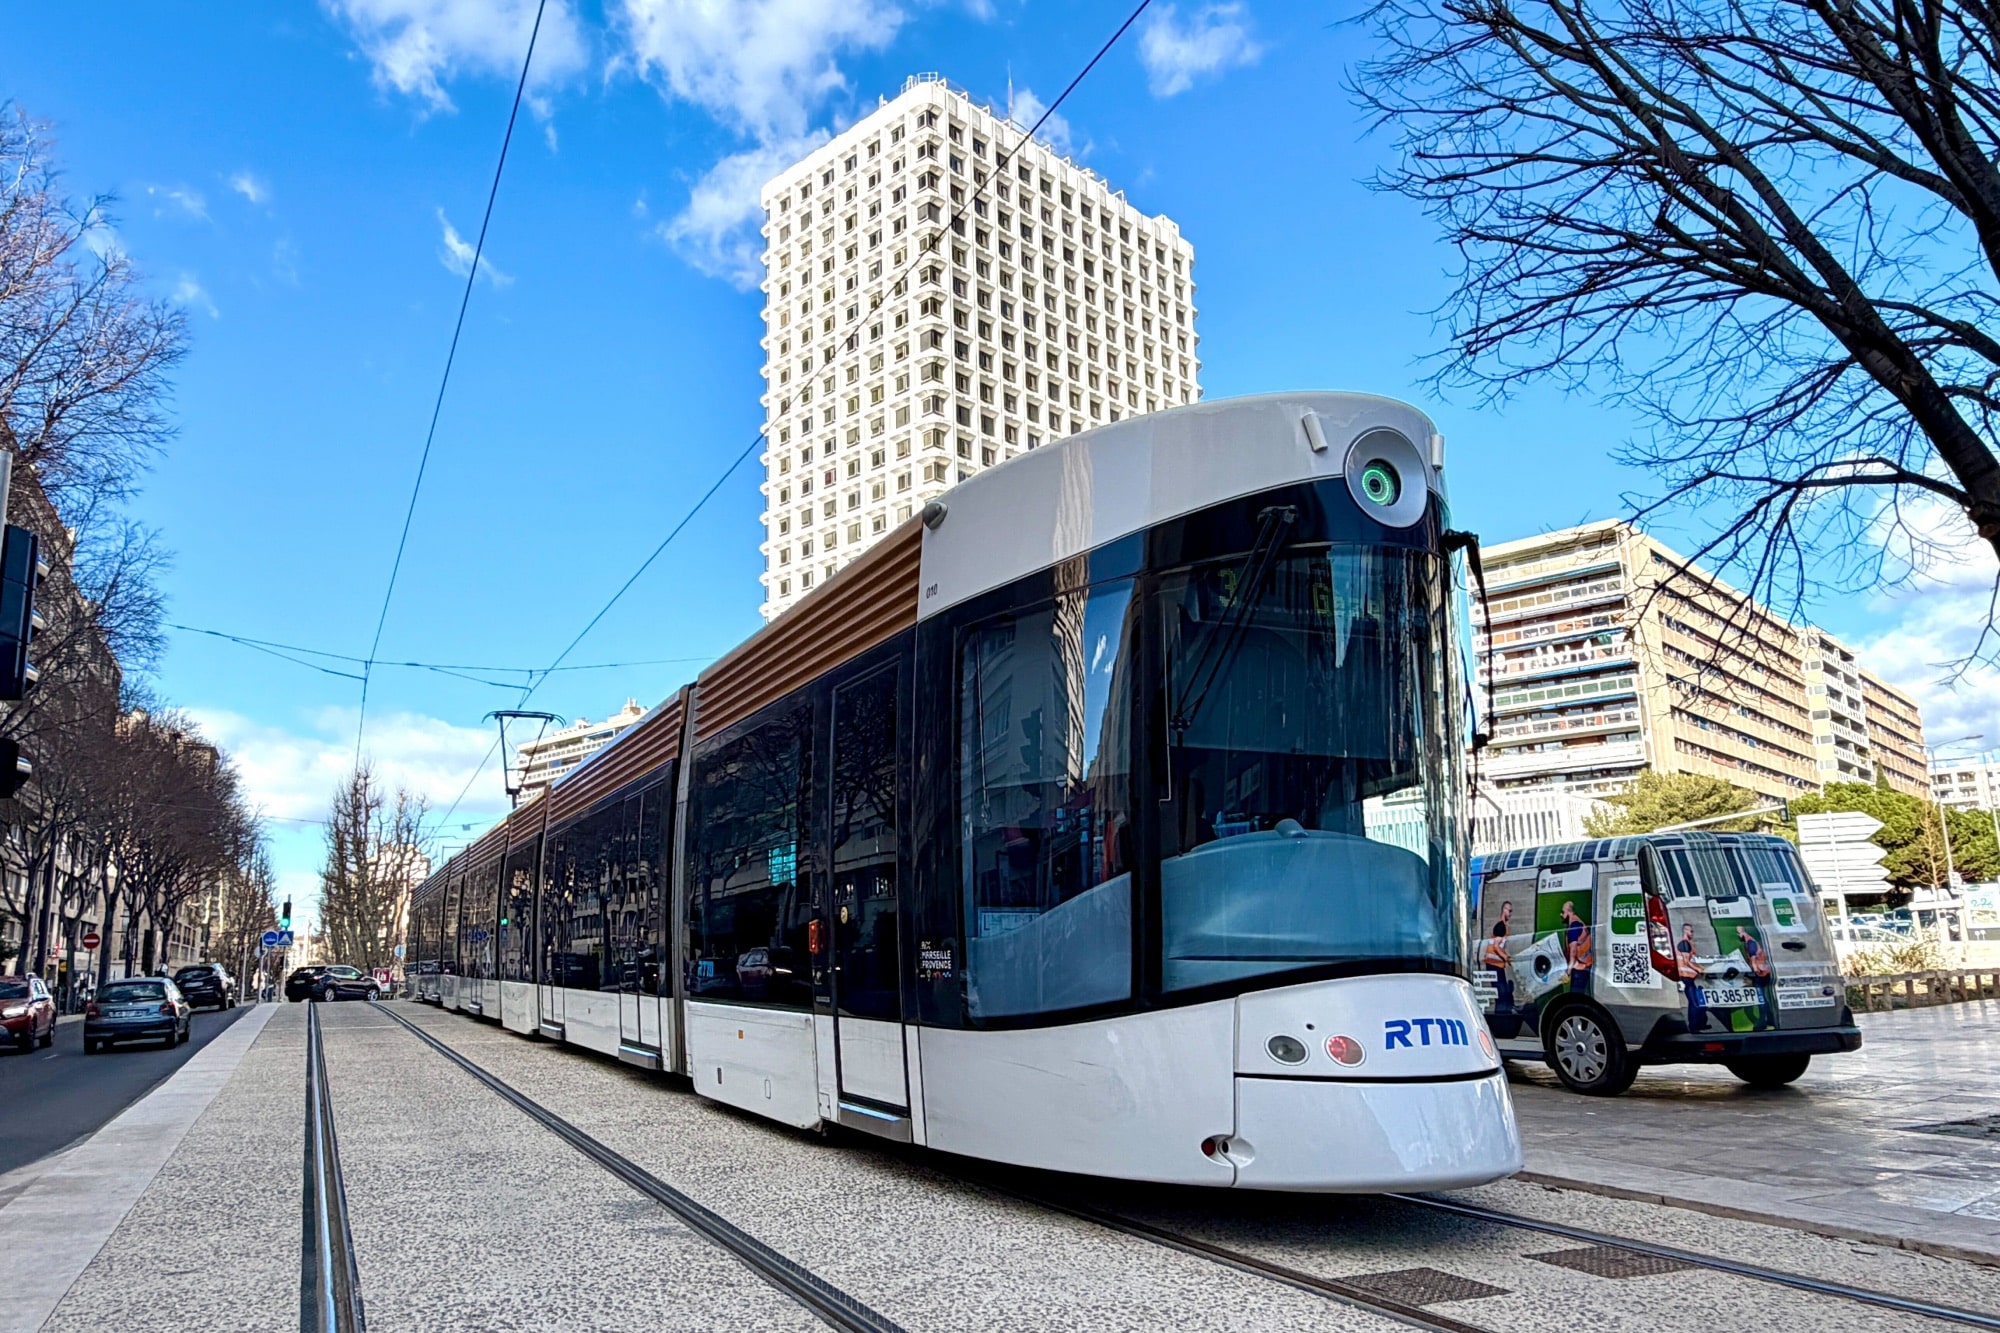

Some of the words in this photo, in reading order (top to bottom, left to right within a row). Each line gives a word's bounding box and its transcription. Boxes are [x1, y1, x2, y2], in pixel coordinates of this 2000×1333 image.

[926, 583, 938, 599] 010
[921, 950, 951, 960] MARSEILLE
[921, 960, 951, 969] PROVENCE
[1385, 1018, 1469, 1050] RTM
